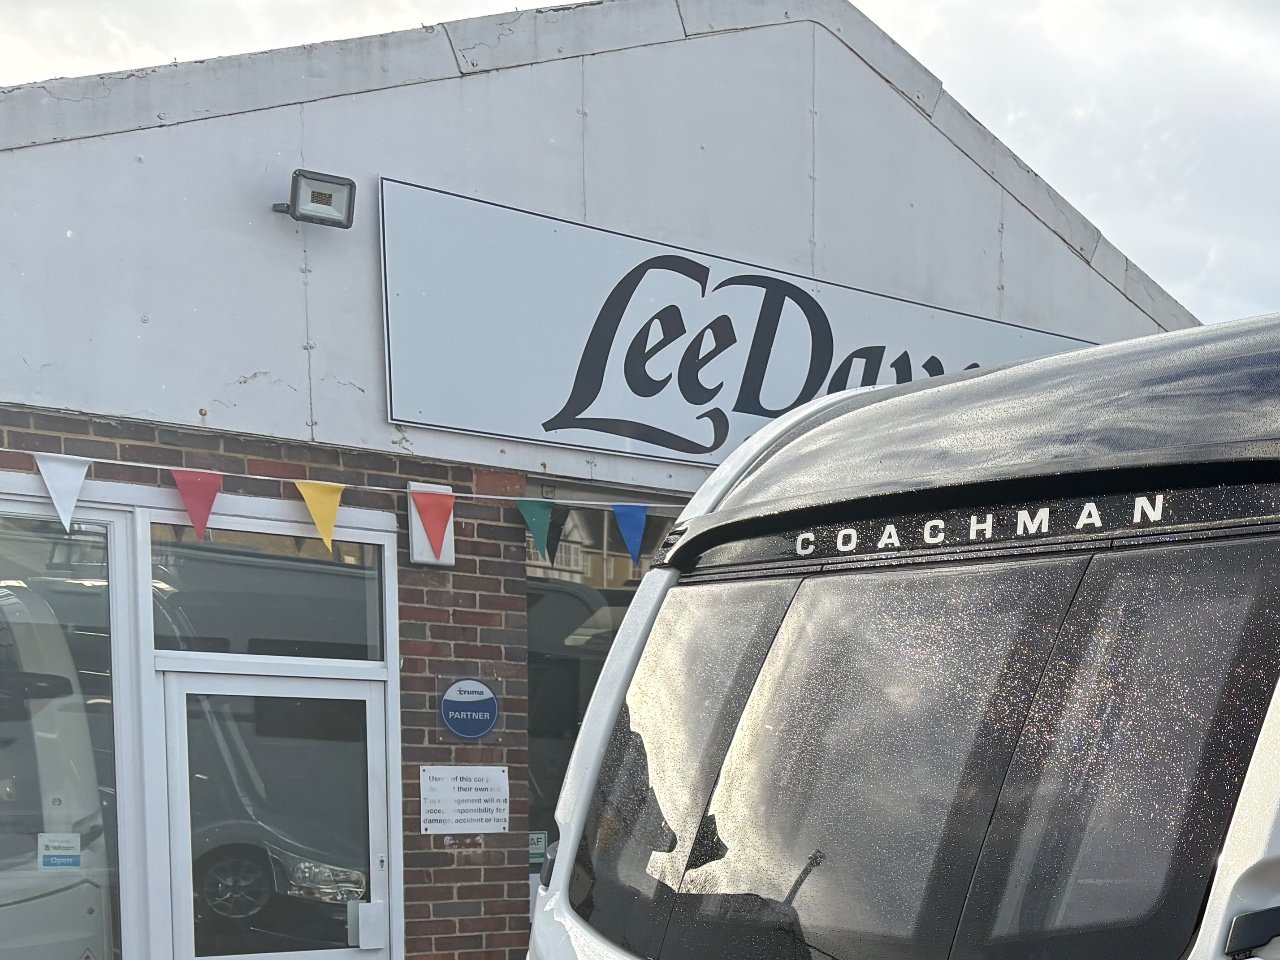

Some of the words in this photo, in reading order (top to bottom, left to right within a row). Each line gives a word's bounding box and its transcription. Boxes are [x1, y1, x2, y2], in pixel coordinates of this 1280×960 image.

[796, 495, 1164, 556] COACHMAN
[457, 688, 484, 696] truma
[449, 711, 490, 720] PARTNER
[50, 857, 72, 865] Open
